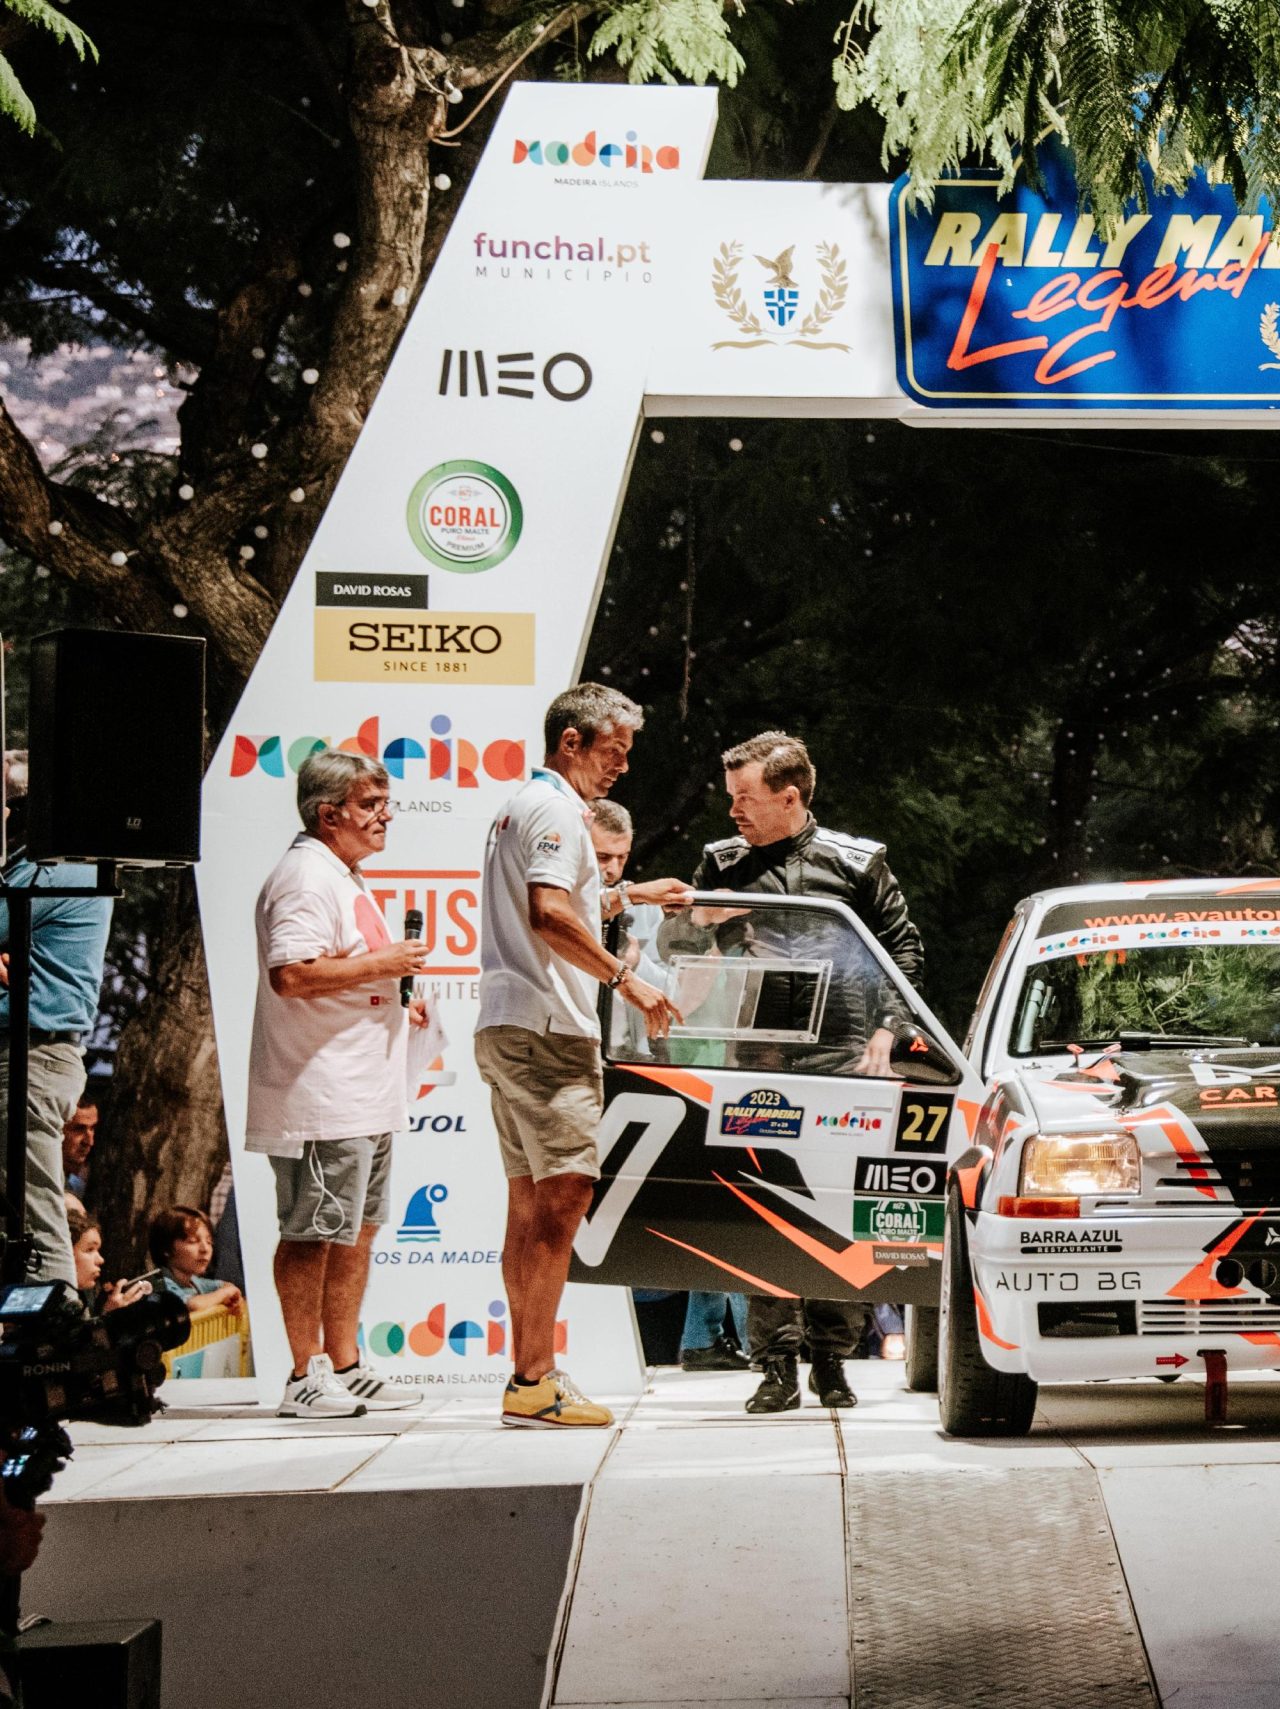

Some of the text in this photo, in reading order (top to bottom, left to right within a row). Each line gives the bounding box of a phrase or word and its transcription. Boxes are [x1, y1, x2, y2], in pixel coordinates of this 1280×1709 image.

[555, 178, 639, 188] MADEIRA ISLANDS
[925, 213, 1152, 268] RALLY
[473, 233, 651, 268] funchal.pt
[475, 267, 653, 284] MUNICÍPIO
[947, 232, 1271, 384] Legend
[439, 349, 592, 401] MEO
[430, 506, 501, 527] CORAL
[446, 541, 485, 552] PREMIUM
[333, 584, 412, 597] DAVID ROSAS
[349, 622, 502, 654] SEIKO
[384, 661, 469, 673] SINCE 1881
[396, 801, 453, 812] LANDS
[537, 841, 560, 851] FPAK
[846, 851, 867, 864] OMP
[750, 1091, 781, 1106] 2023
[1200, 1087, 1278, 1101] CAR
[724, 1106, 802, 1119] RALLY MADEIRA
[409, 1115, 467, 1132] SOL
[902, 1104, 948, 1141] 27
[864, 1164, 936, 1193] MEO
[876, 1212, 920, 1229] CORAL
[875, 1251, 925, 1260] DAVID ROSAS
[1037, 1245, 1108, 1253] RESTAURANTE
[408, 1251, 434, 1264] DA
[996, 1271, 1141, 1291] AUTO BG
[23, 1361, 71, 1376] RONIN
[389, 1373, 506, 1384] ADEIRA ISLANDS
